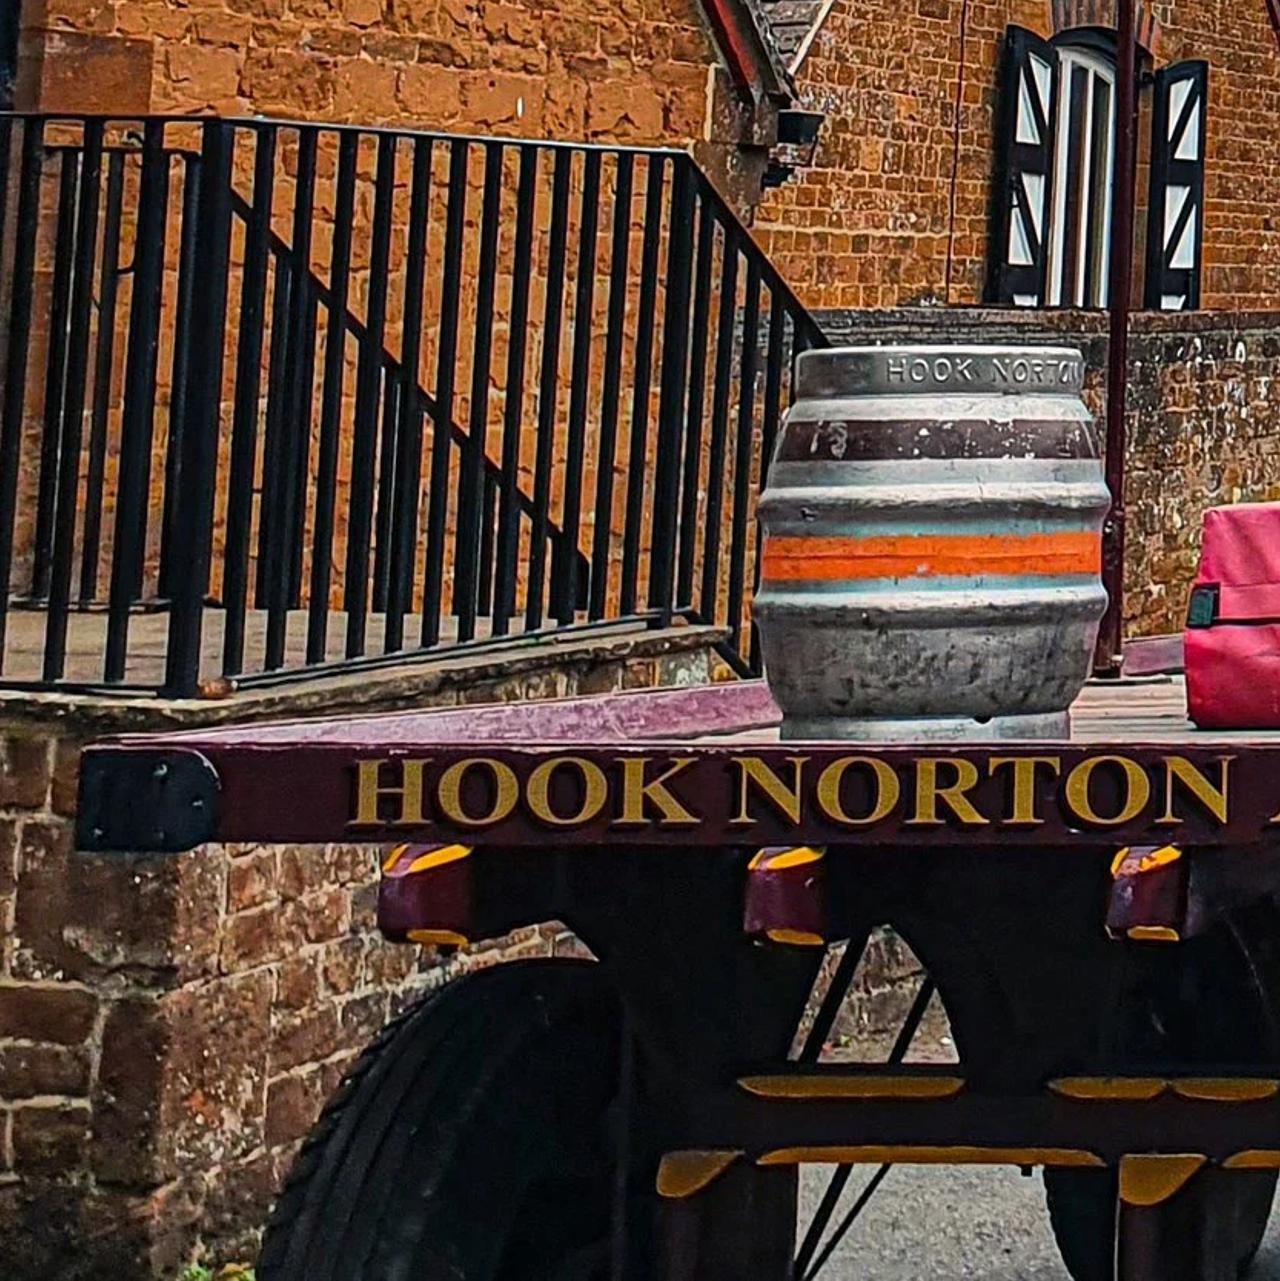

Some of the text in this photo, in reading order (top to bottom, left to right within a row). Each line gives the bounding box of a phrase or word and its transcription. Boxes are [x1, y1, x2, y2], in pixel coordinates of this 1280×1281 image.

[887, 357, 975, 384] HOOK
[348, 757, 701, 825] HOOK
[729, 756, 1230, 824] NORTON
